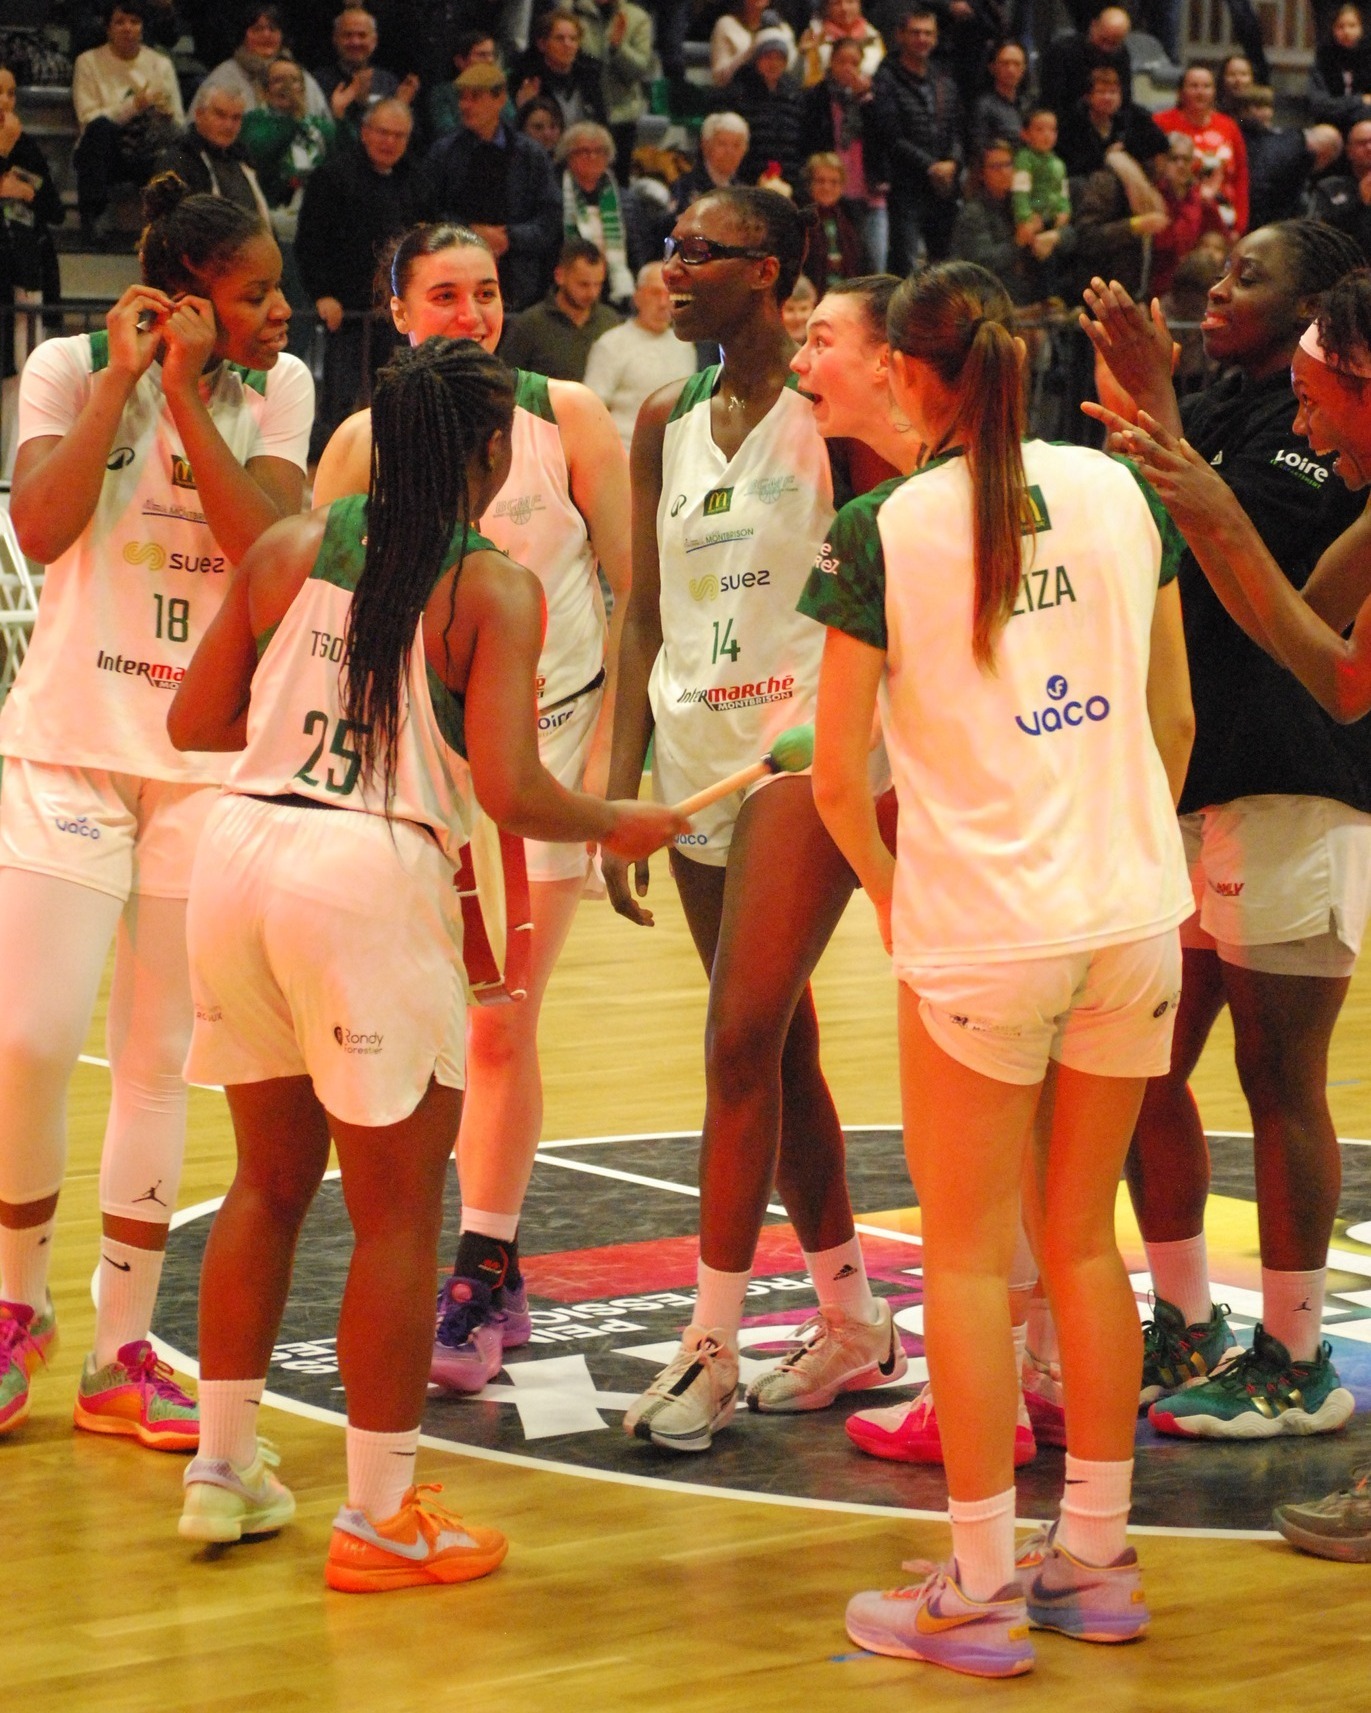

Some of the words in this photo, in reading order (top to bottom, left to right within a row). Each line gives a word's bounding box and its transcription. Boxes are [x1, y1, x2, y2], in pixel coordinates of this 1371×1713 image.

[1275, 450, 1329, 483] Loire
[153, 593, 190, 643] 18
[311, 629, 351, 668] TSO
[712, 618, 741, 664] 14
[538, 710, 574, 730] oir
[718, 691, 791, 711] MONTBRISON
[293, 710, 374, 796] 25
